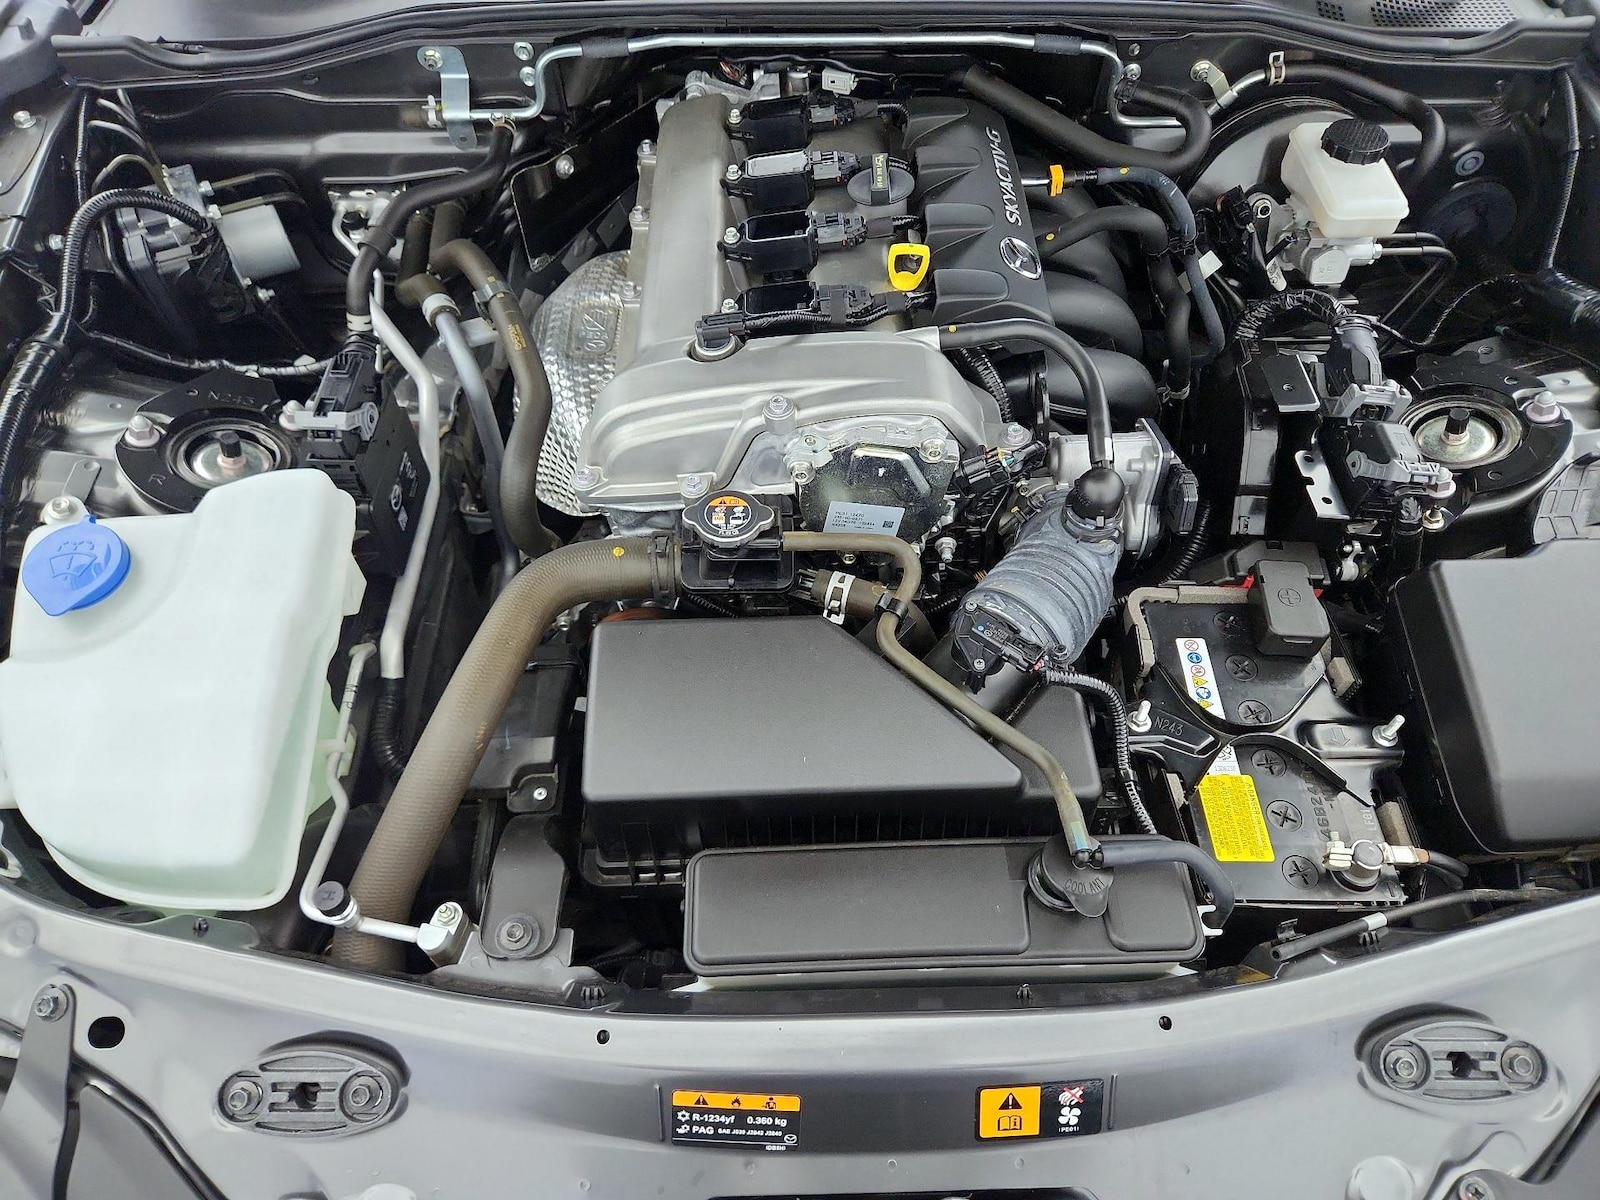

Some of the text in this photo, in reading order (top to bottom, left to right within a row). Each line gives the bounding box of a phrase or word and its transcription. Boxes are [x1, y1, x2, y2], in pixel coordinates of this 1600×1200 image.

[985, 126, 1022, 226] SKYACTIV-G
[1154, 716, 1184, 736] N243
[1065, 876, 1105, 895] COOLANT
[692, 1113, 788, 1127] R-1234yf 0.360 kg
[692, 1125, 715, 1135] PAG
